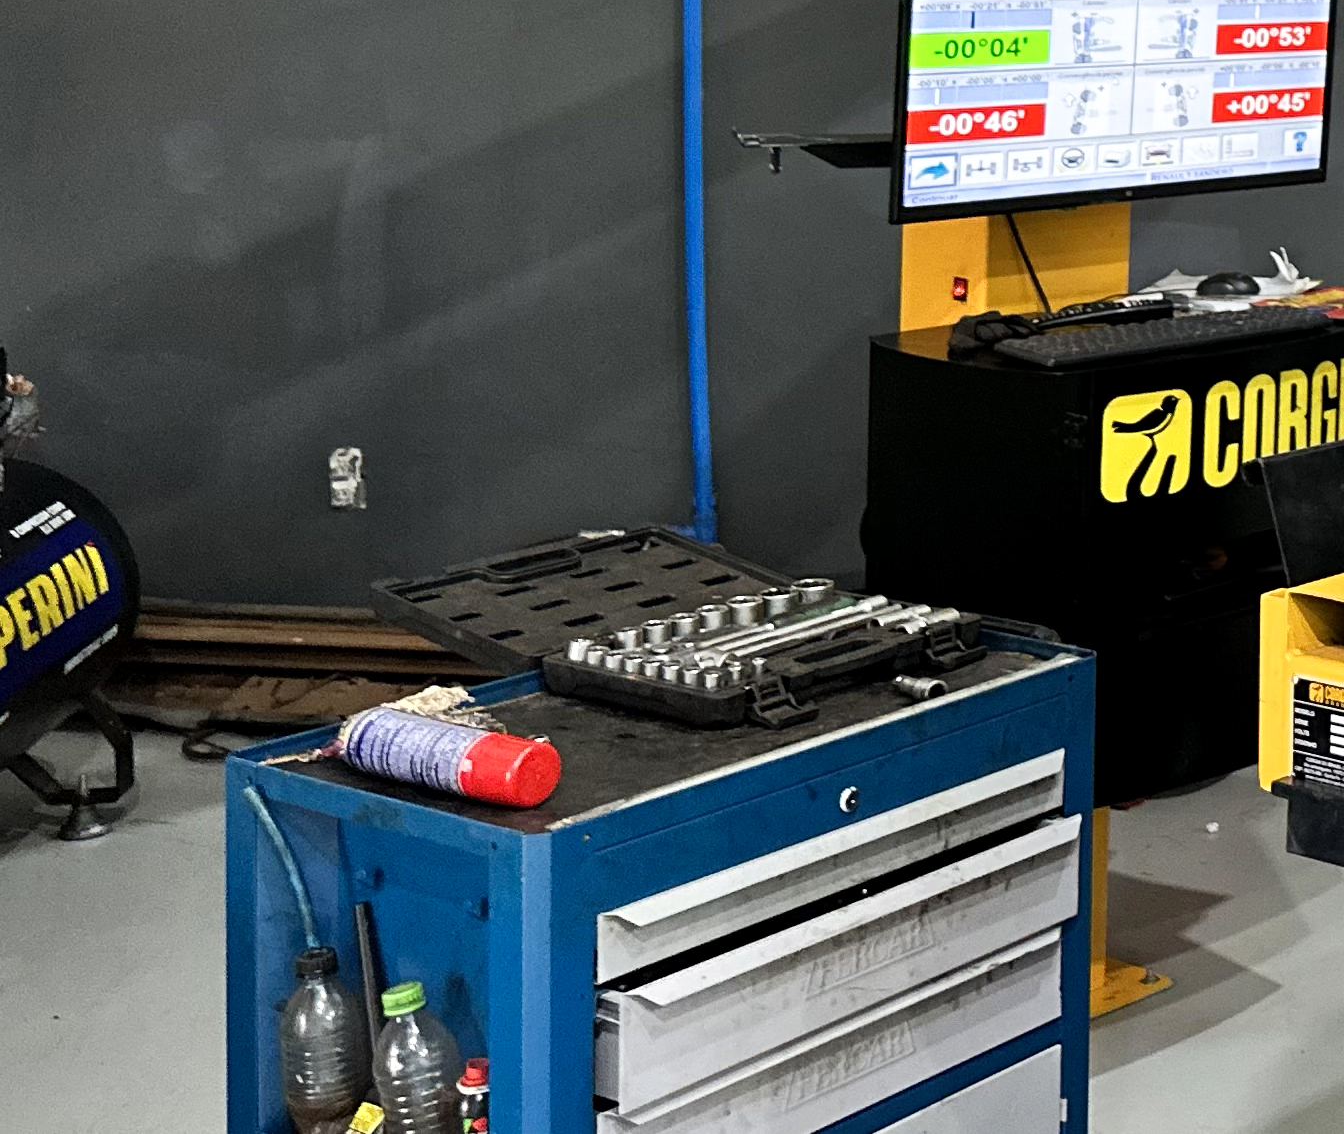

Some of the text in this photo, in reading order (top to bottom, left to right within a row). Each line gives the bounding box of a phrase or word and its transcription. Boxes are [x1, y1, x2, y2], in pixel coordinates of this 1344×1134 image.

[934, 37, 1028, 60] -00°04'
[1233, 25, 1312, 49] -00°53'
[1226, 91, 1311, 115] +00°45'
[928, 109, 1026, 137] -00°46'
